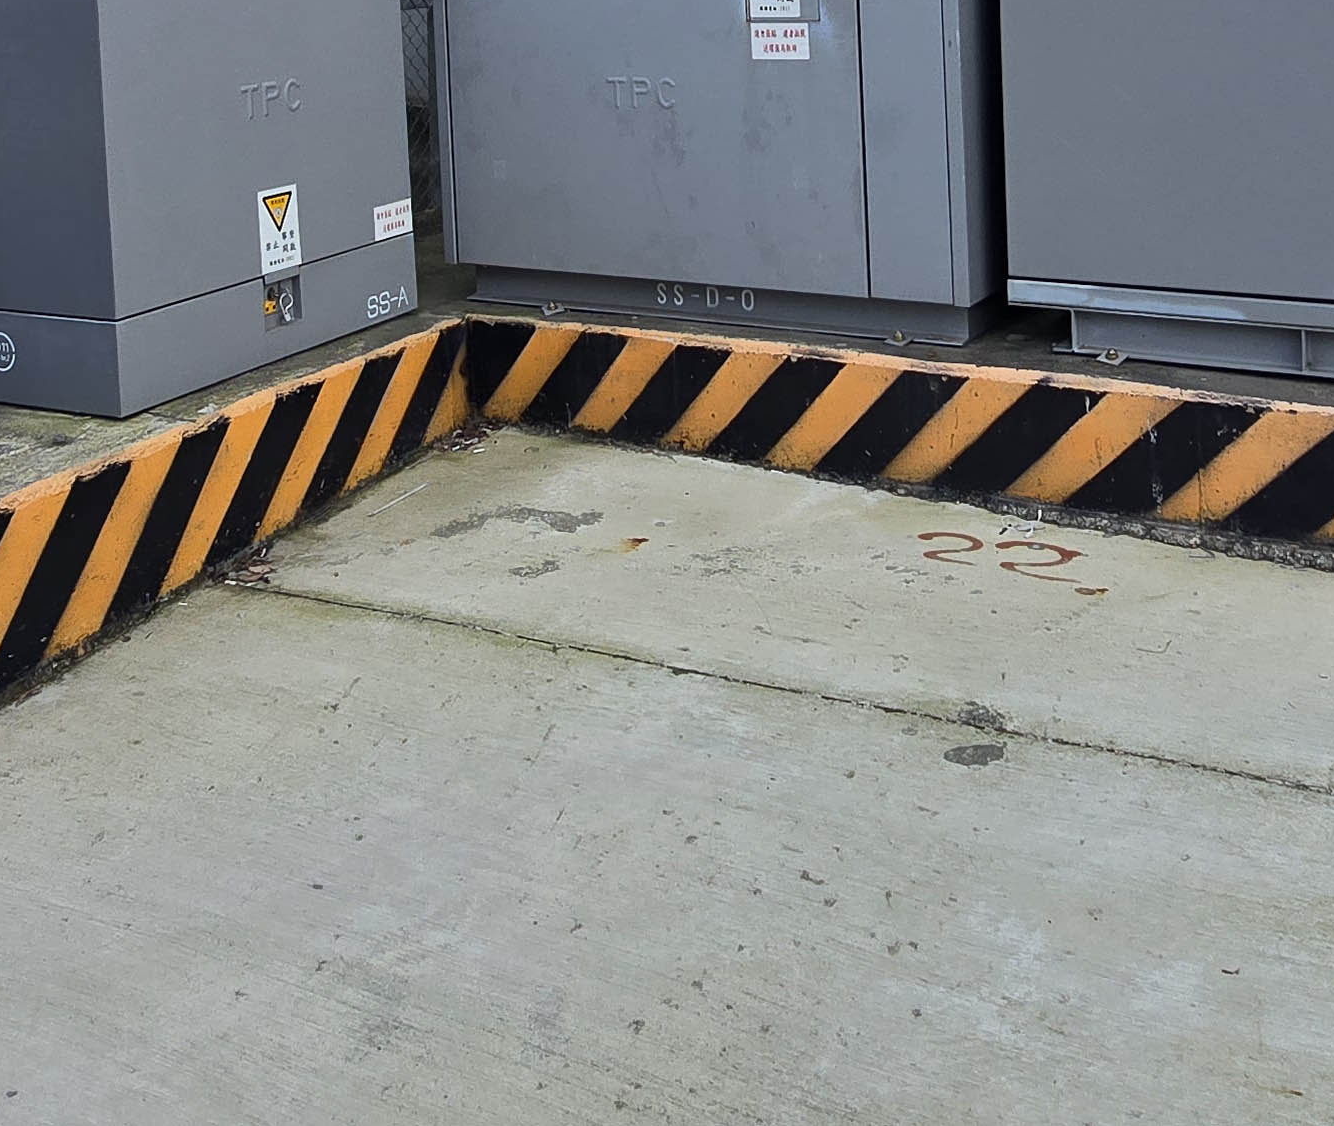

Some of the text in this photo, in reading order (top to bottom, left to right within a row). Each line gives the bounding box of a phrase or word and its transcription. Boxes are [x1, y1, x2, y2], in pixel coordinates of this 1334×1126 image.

[240, 78, 301, 120] TPC
[606, 76, 676, 110] TPC
[367, 285, 409, 319] SS-A
